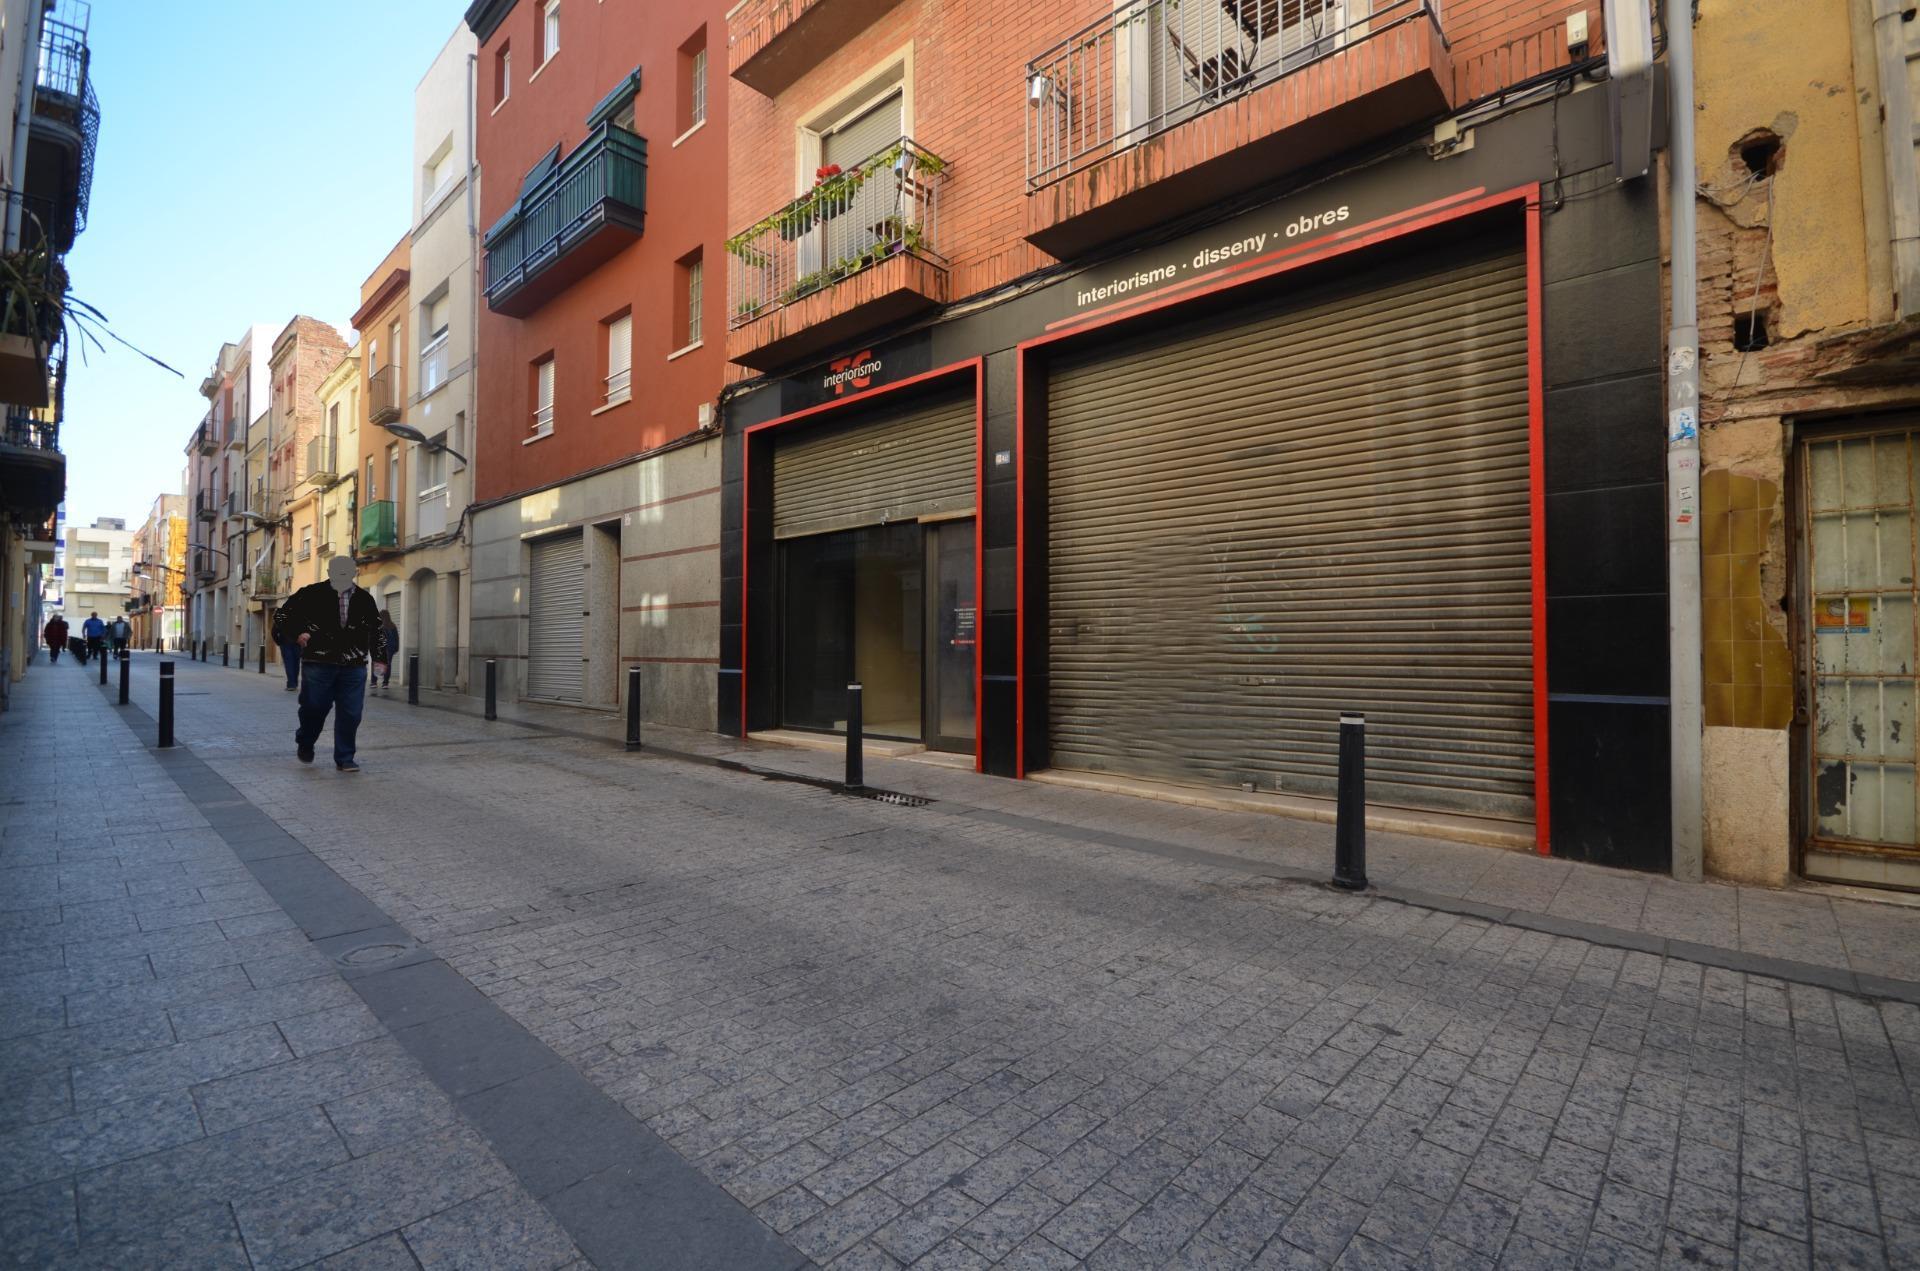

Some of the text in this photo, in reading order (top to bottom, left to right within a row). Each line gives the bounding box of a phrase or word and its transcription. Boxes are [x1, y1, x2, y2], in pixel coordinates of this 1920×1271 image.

[1077, 205, 1350, 306] interiorisme disseny obres
[823, 360, 882, 388] interiorismo
